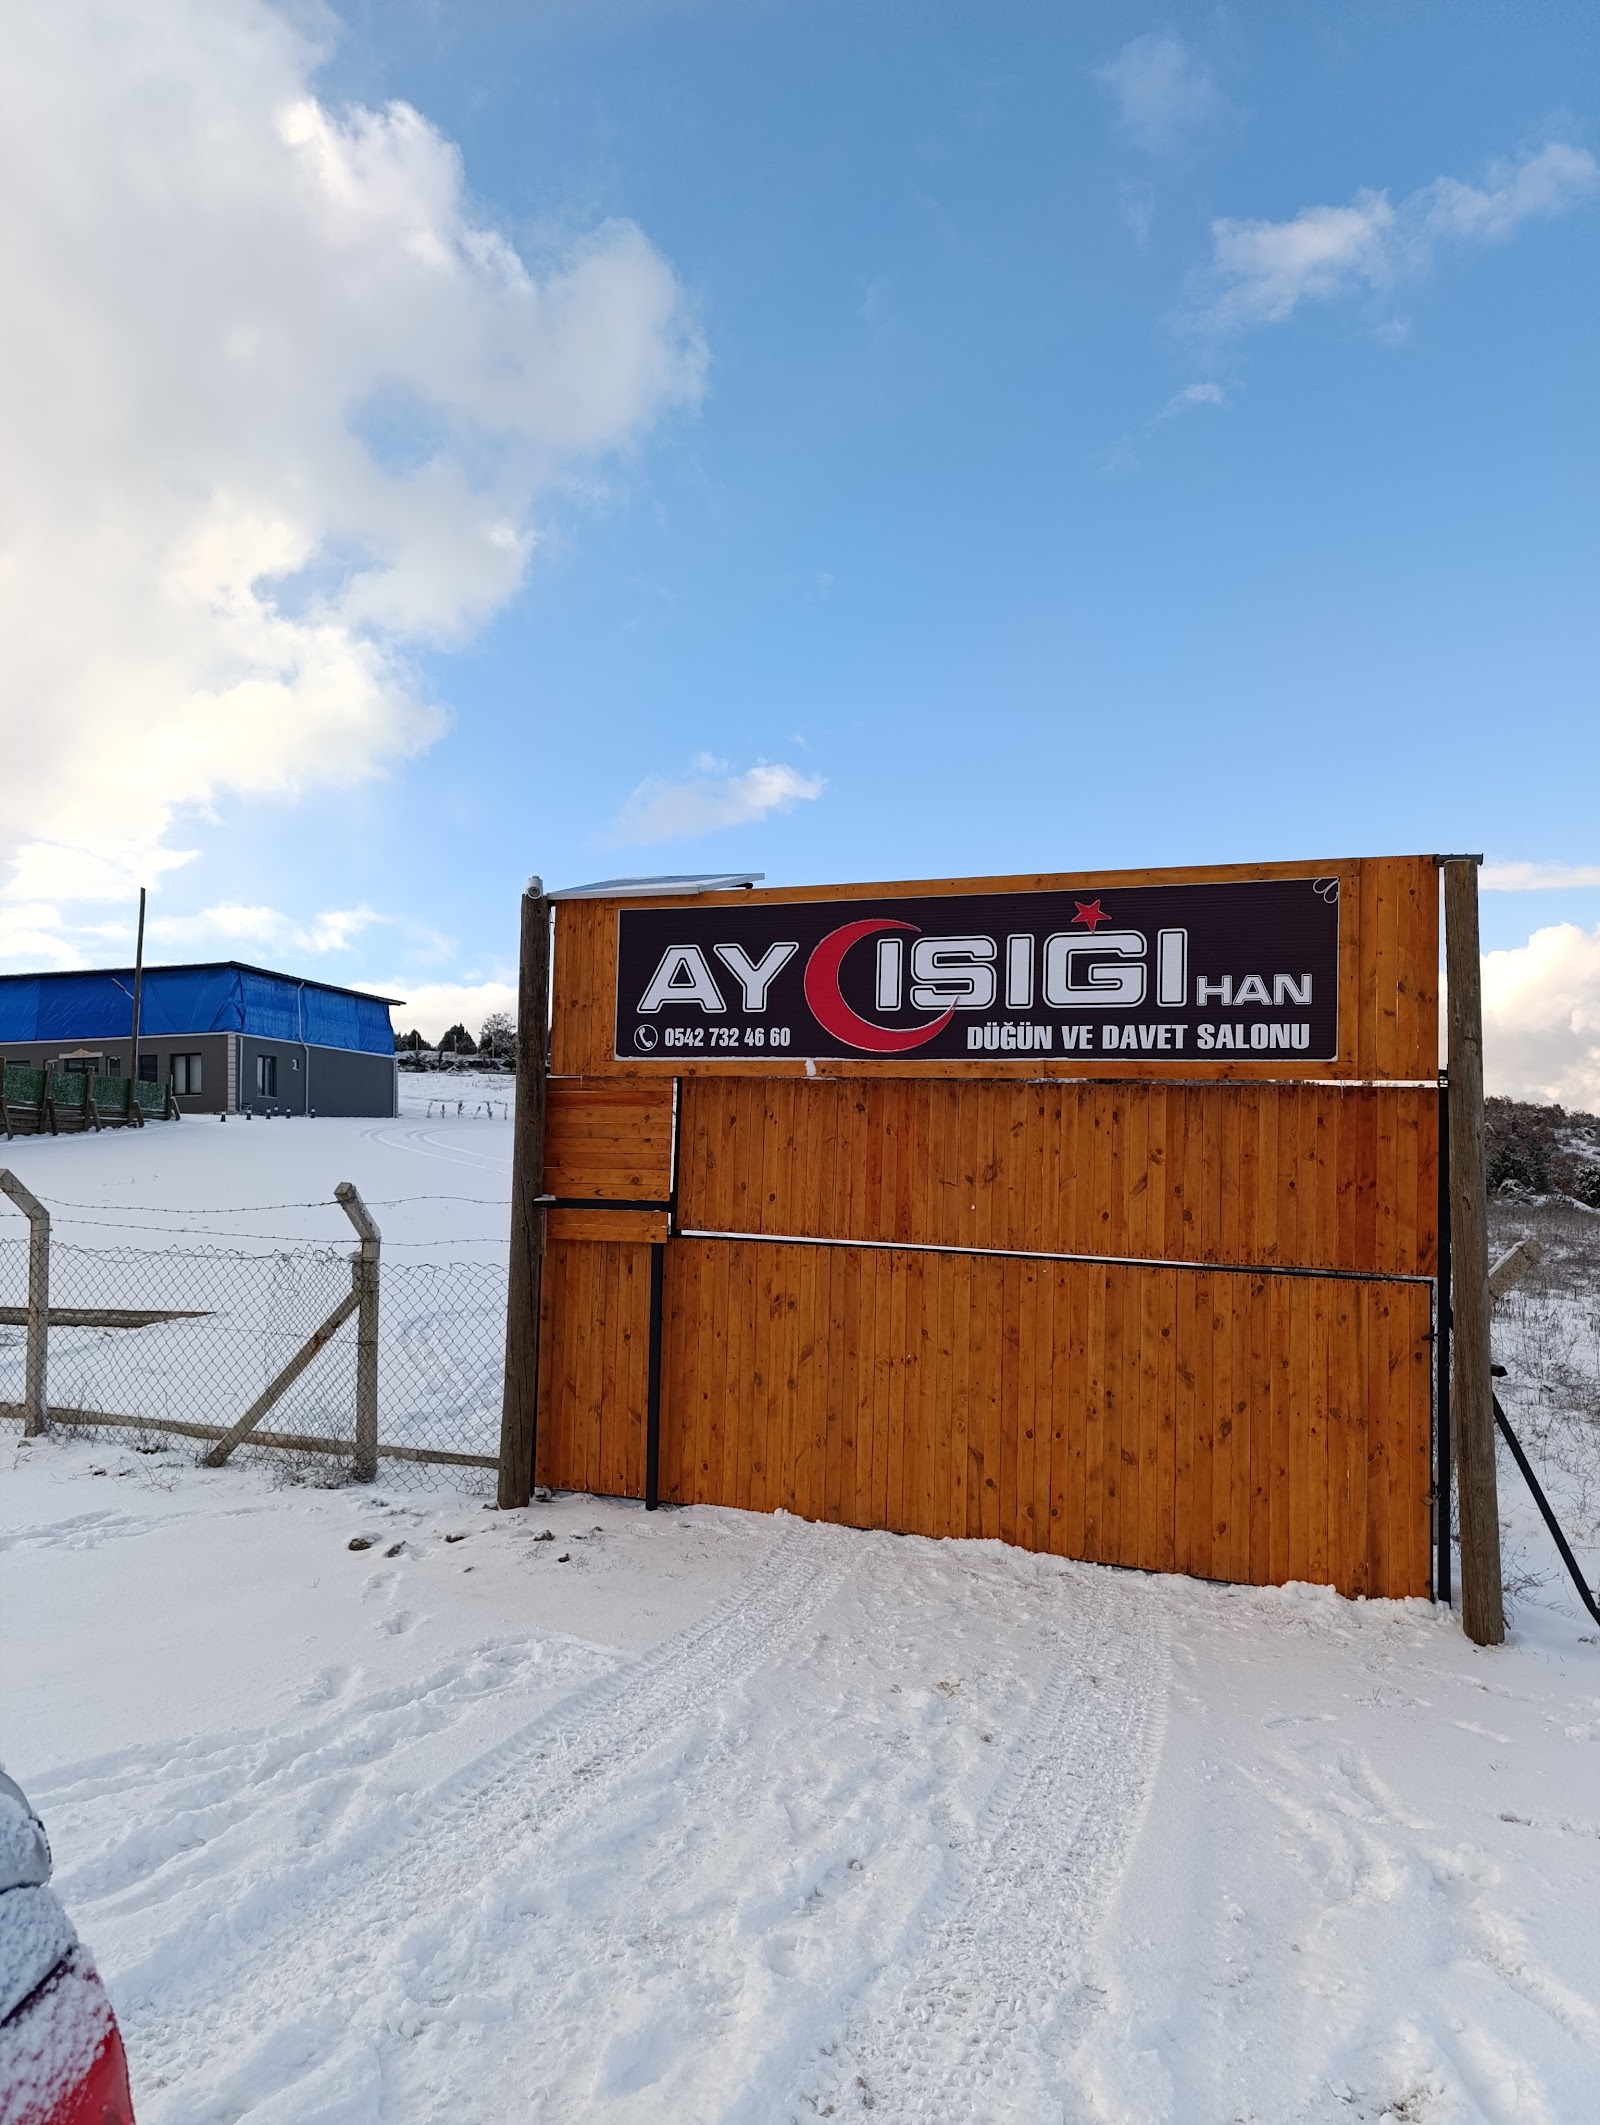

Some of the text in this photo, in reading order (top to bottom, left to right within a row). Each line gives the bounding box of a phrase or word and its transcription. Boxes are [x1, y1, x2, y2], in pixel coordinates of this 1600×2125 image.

[636, 941, 799, 1014] AY
[1196, 973, 1313, 1006] HAN
[664, 1027, 791, 1047] 0542 732 46 60
[966, 1021, 1311, 1050] DÜĞÜN VE DAVET SALONU
